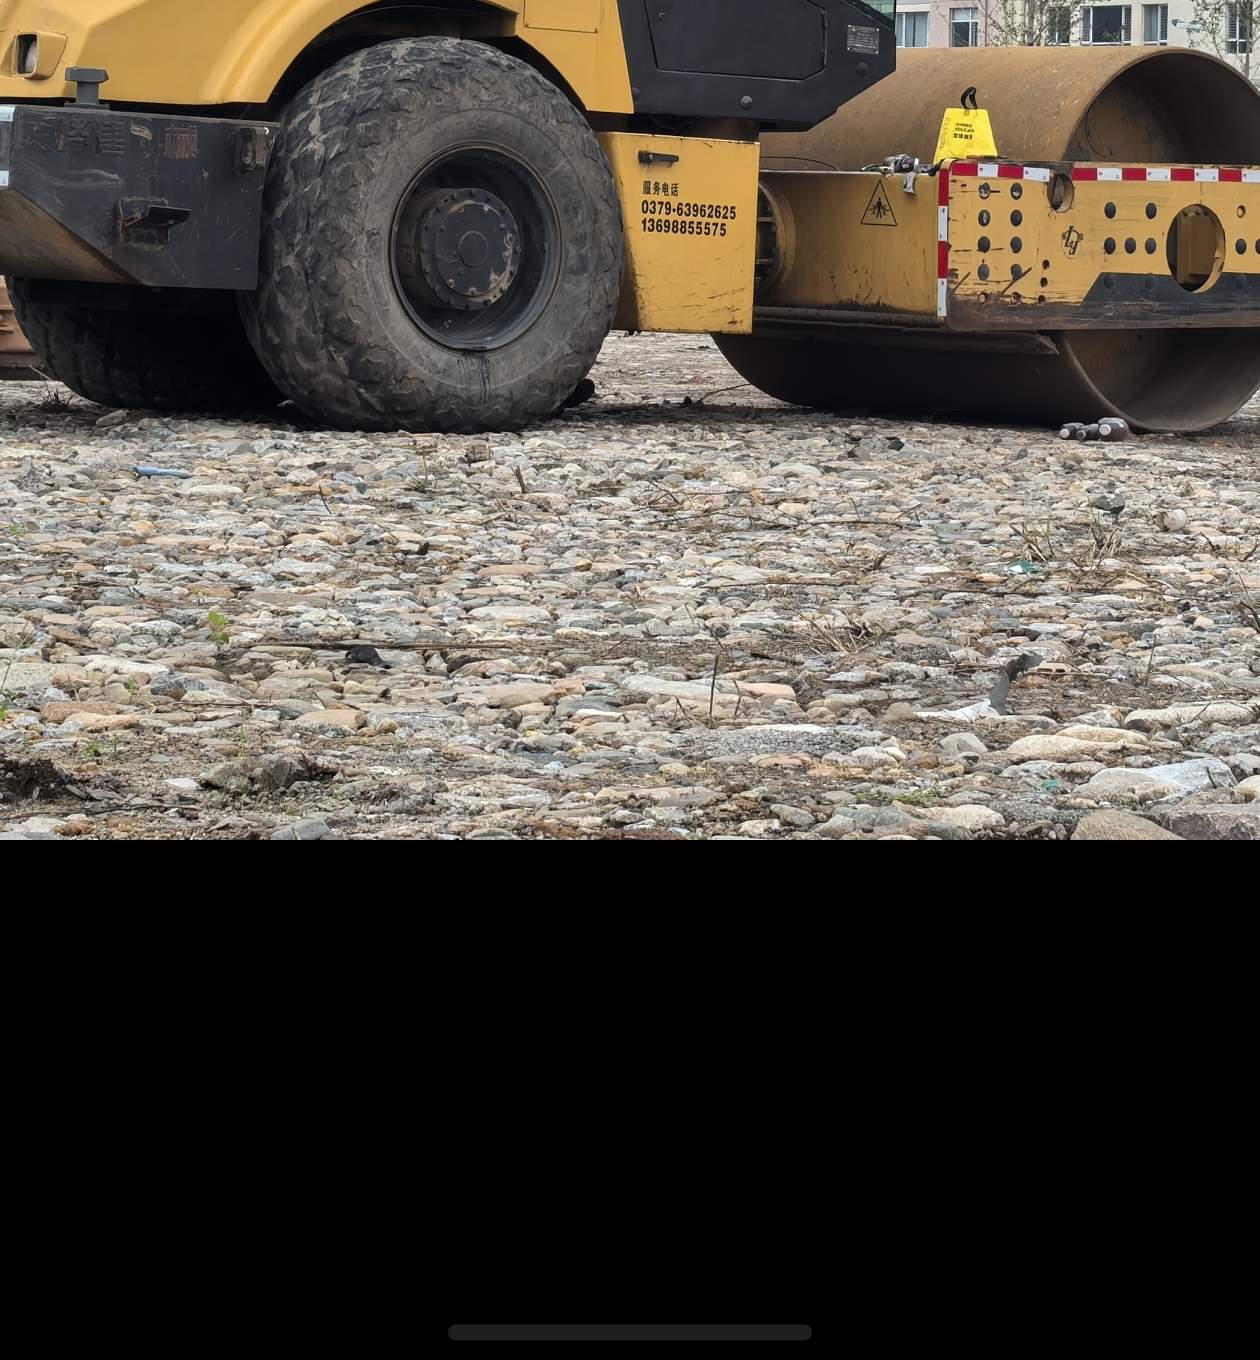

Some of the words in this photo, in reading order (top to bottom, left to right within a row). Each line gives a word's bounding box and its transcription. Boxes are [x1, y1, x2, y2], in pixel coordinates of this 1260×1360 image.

[643, 180, 679, 197] 服务电话
[641, 200, 736, 219] 0379-63962625
[641, 218, 727, 237] 13698855575
